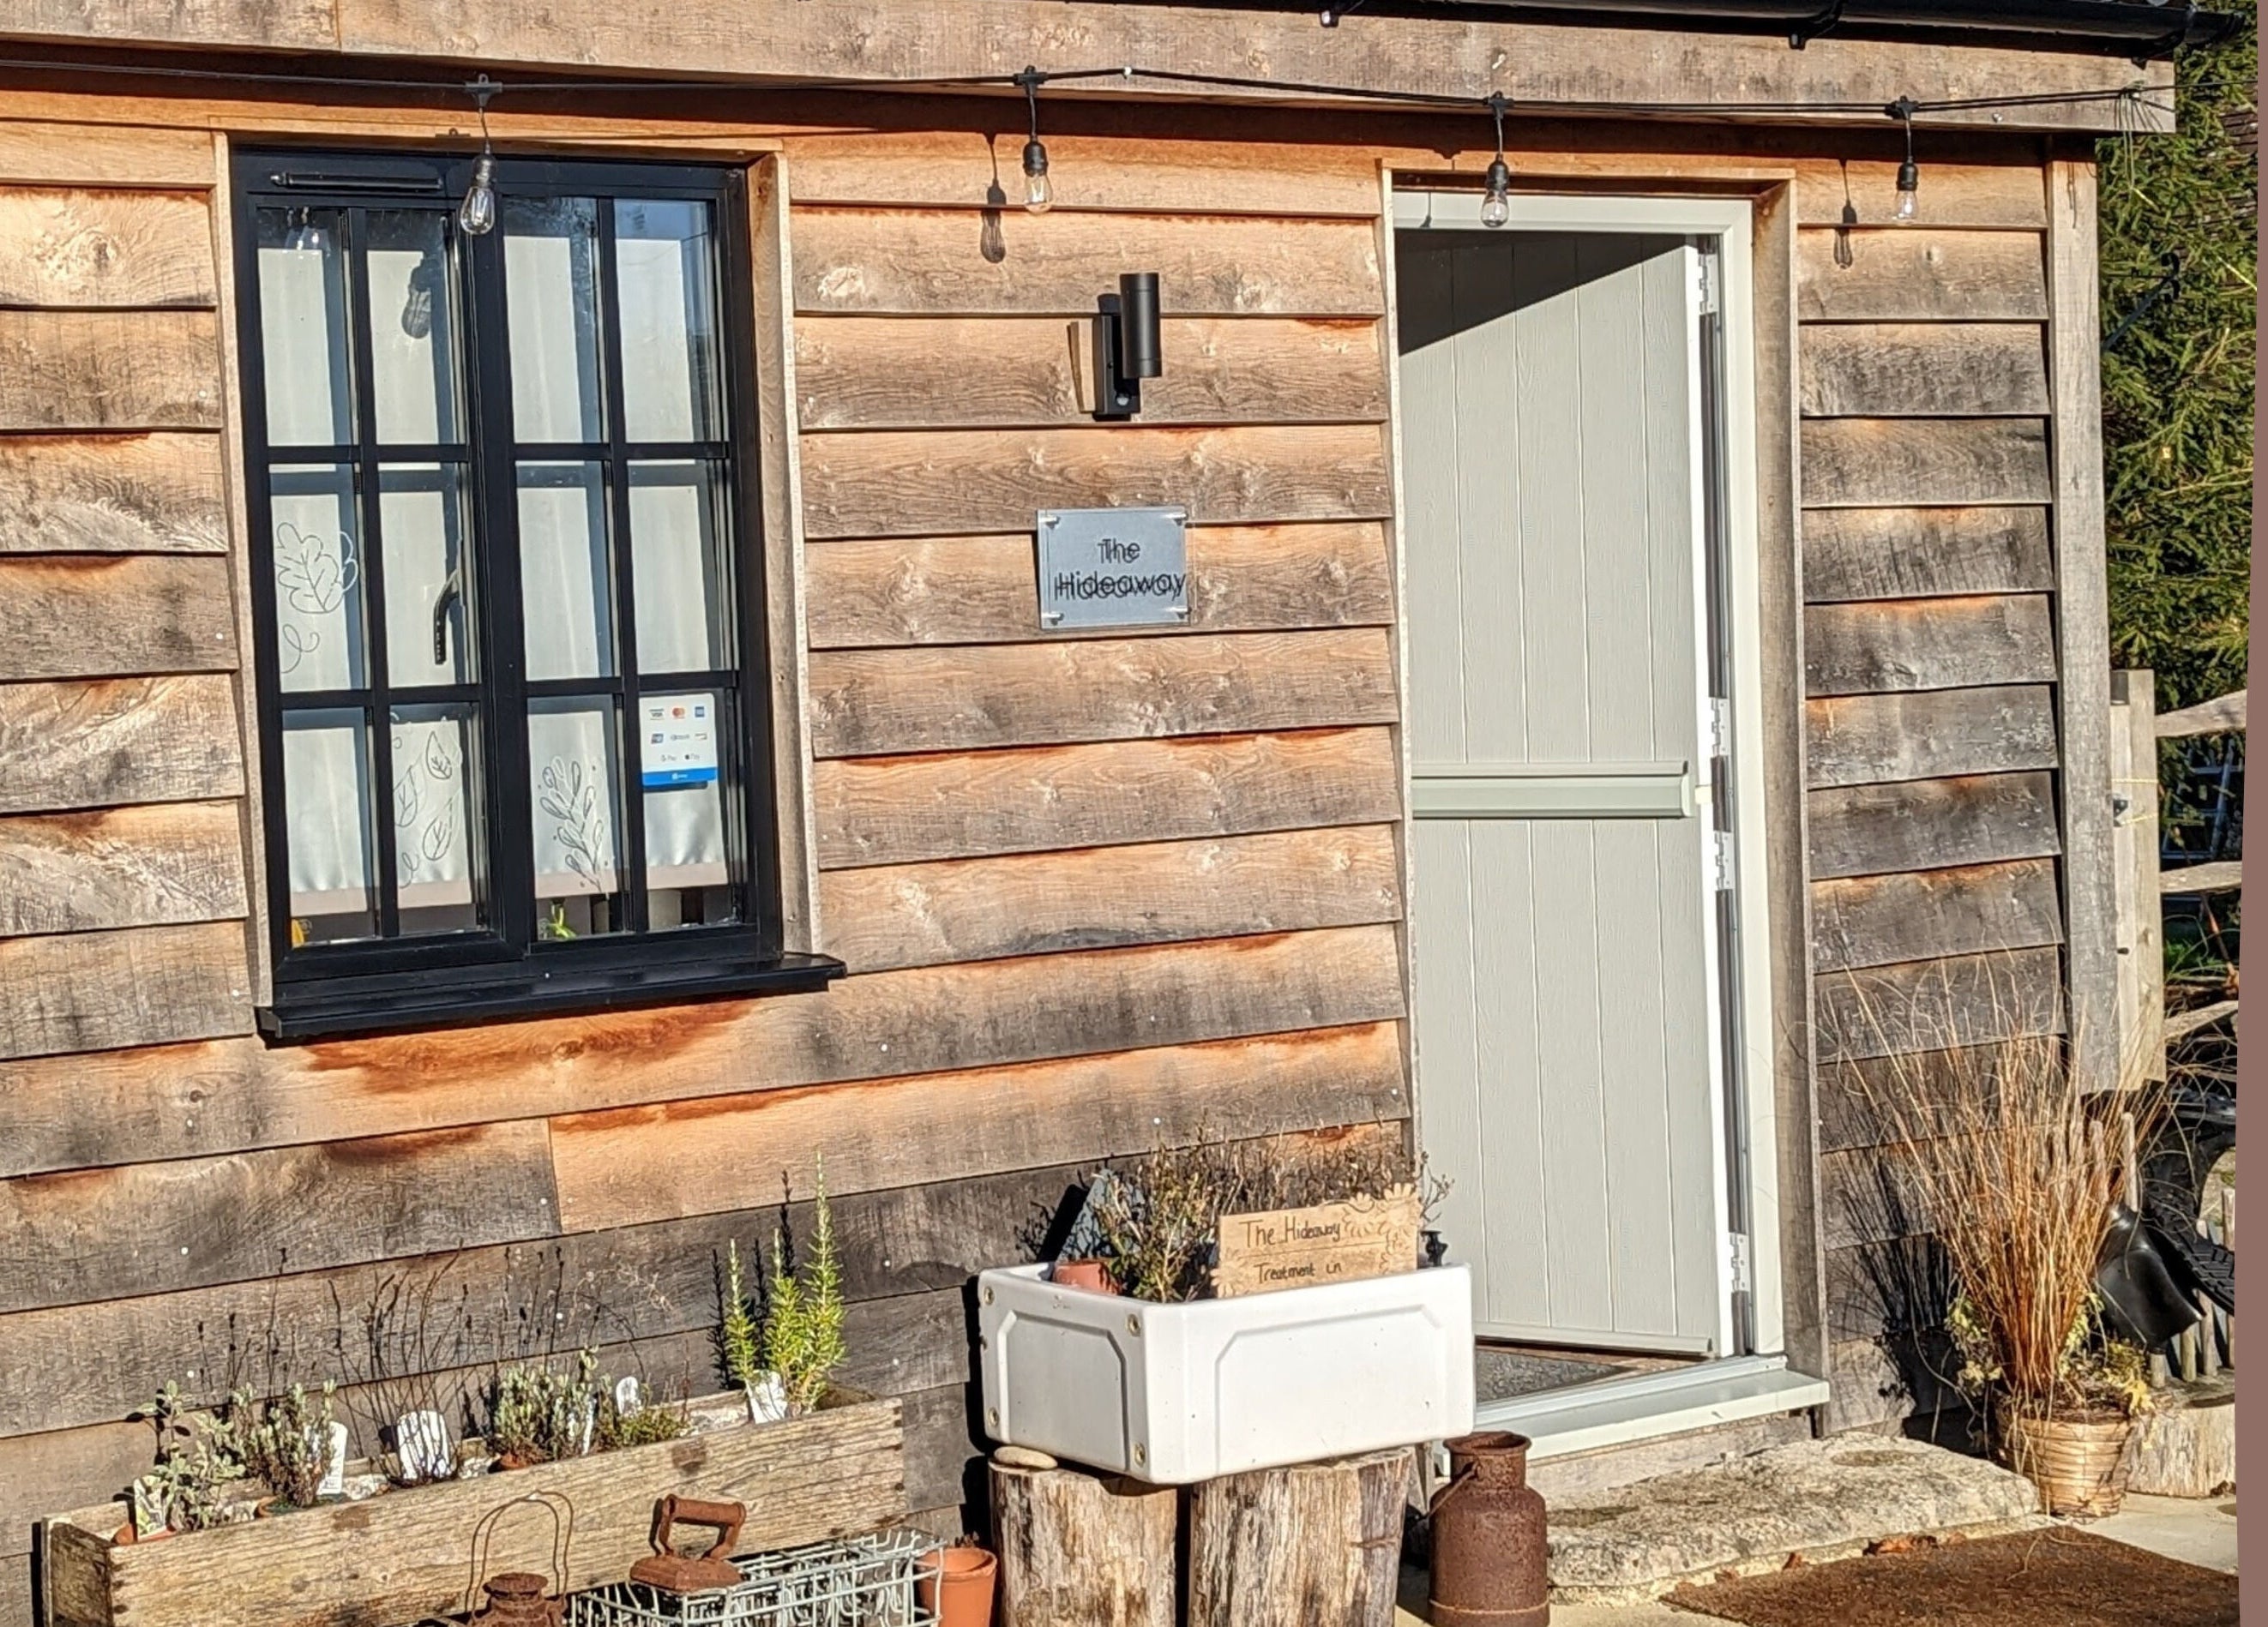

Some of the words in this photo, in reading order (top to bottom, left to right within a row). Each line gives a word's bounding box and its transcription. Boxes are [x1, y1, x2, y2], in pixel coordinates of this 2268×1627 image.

[1098, 537, 1140, 562] The
[1056, 571, 1186, 599] Hideaway
[1239, 1219, 1277, 1247] The
[1326, 1263, 1342, 1275] in
